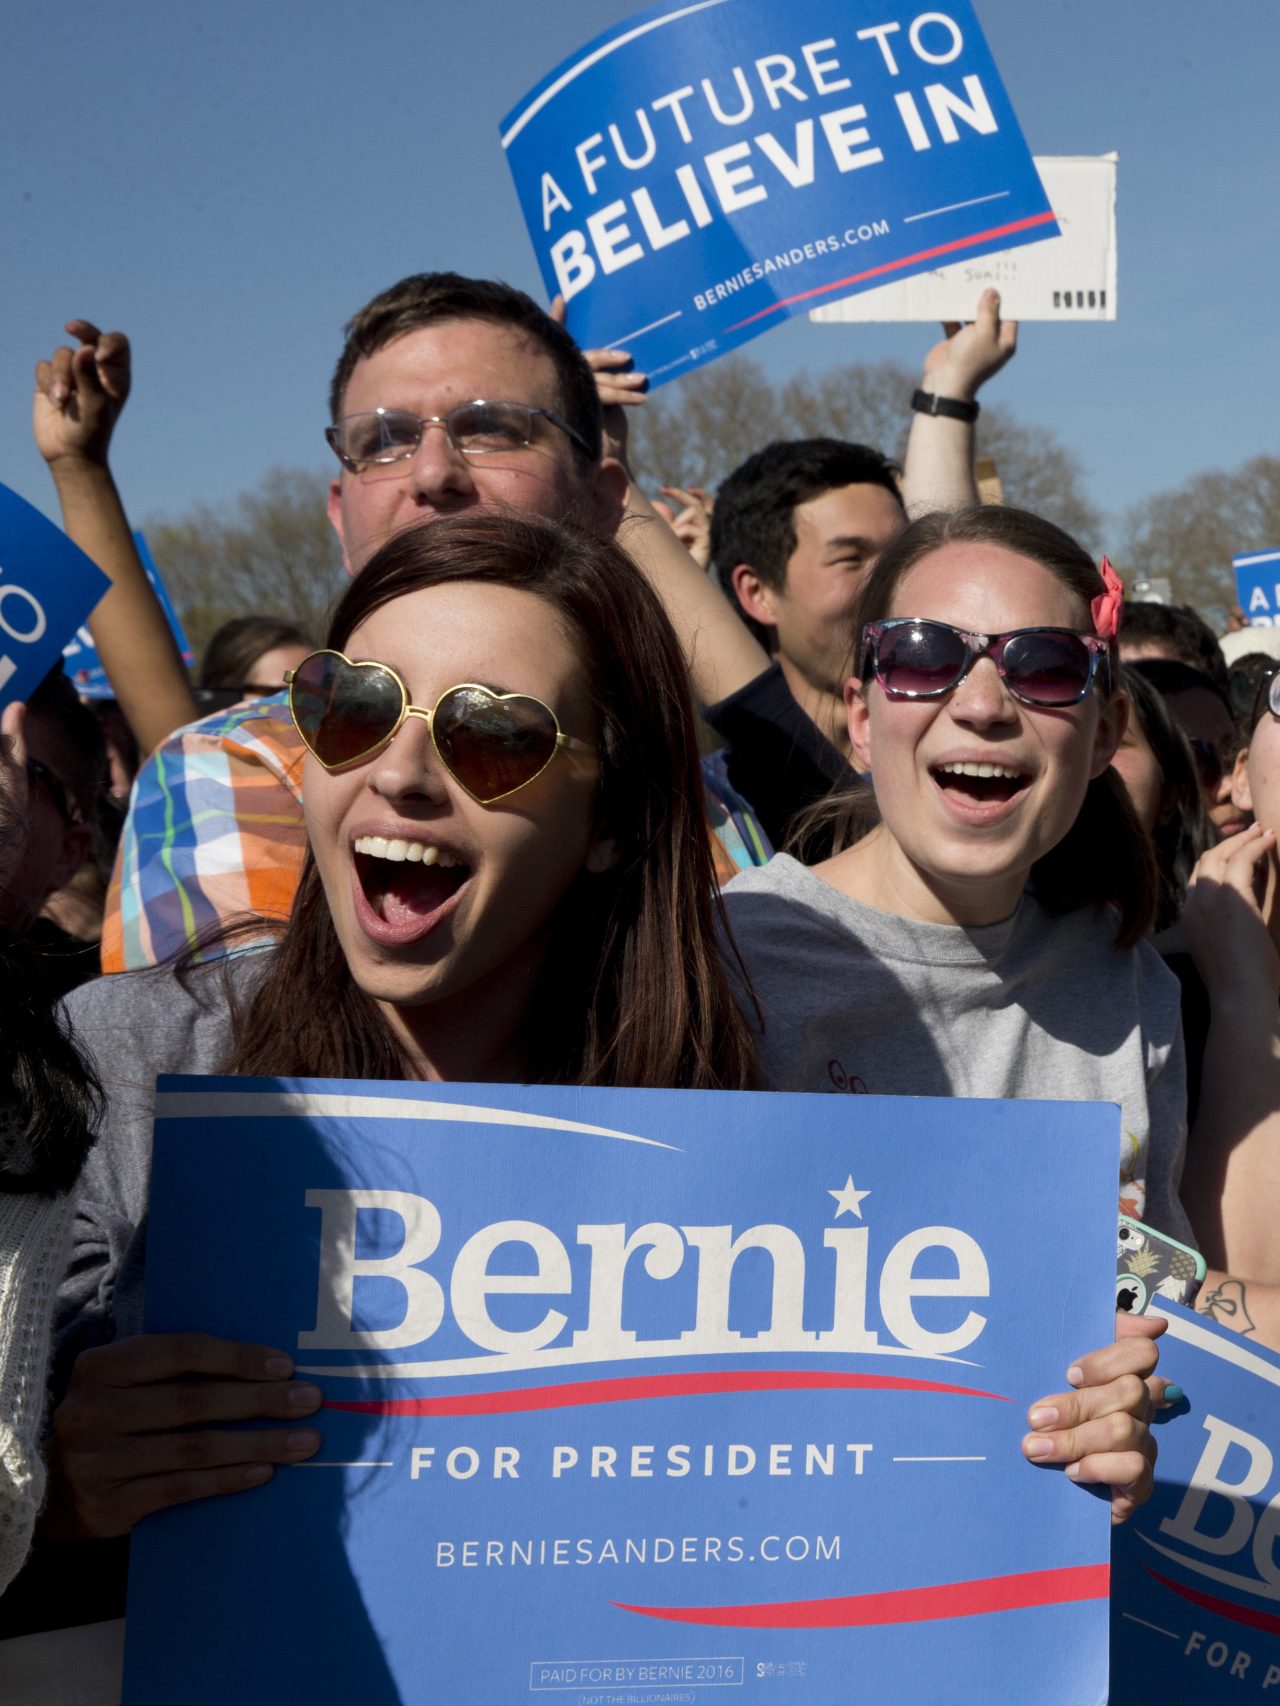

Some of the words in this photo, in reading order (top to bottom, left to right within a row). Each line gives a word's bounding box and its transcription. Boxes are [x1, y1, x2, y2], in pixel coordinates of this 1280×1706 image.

[543, 172, 572, 231] A
[575, 38, 851, 195] FUTURE
[857, 12, 963, 75] TO
[549, 104, 883, 302] BELIEVE
[895, 74, 998, 152] IN
[694, 220, 890, 311] BERNIESANDERS.COM
[1250, 587, 1270, 612] A
[297, 1174, 990, 1356] Bernie
[409, 1446, 521, 1481] FOR
[552, 1443, 875, 1479] PRESIDENT
[436, 1535, 843, 1569] BERNIESANDERS.COM
[540, 1668, 577, 1683] PAID
[580, 1667, 613, 1682] FOR
[615, 1666, 635, 1681] BY
[638, 1664, 693, 1680] BERNIE
[696, 1663, 734, 1678] 2016
[1184, 1630, 1252, 1680] FOR
